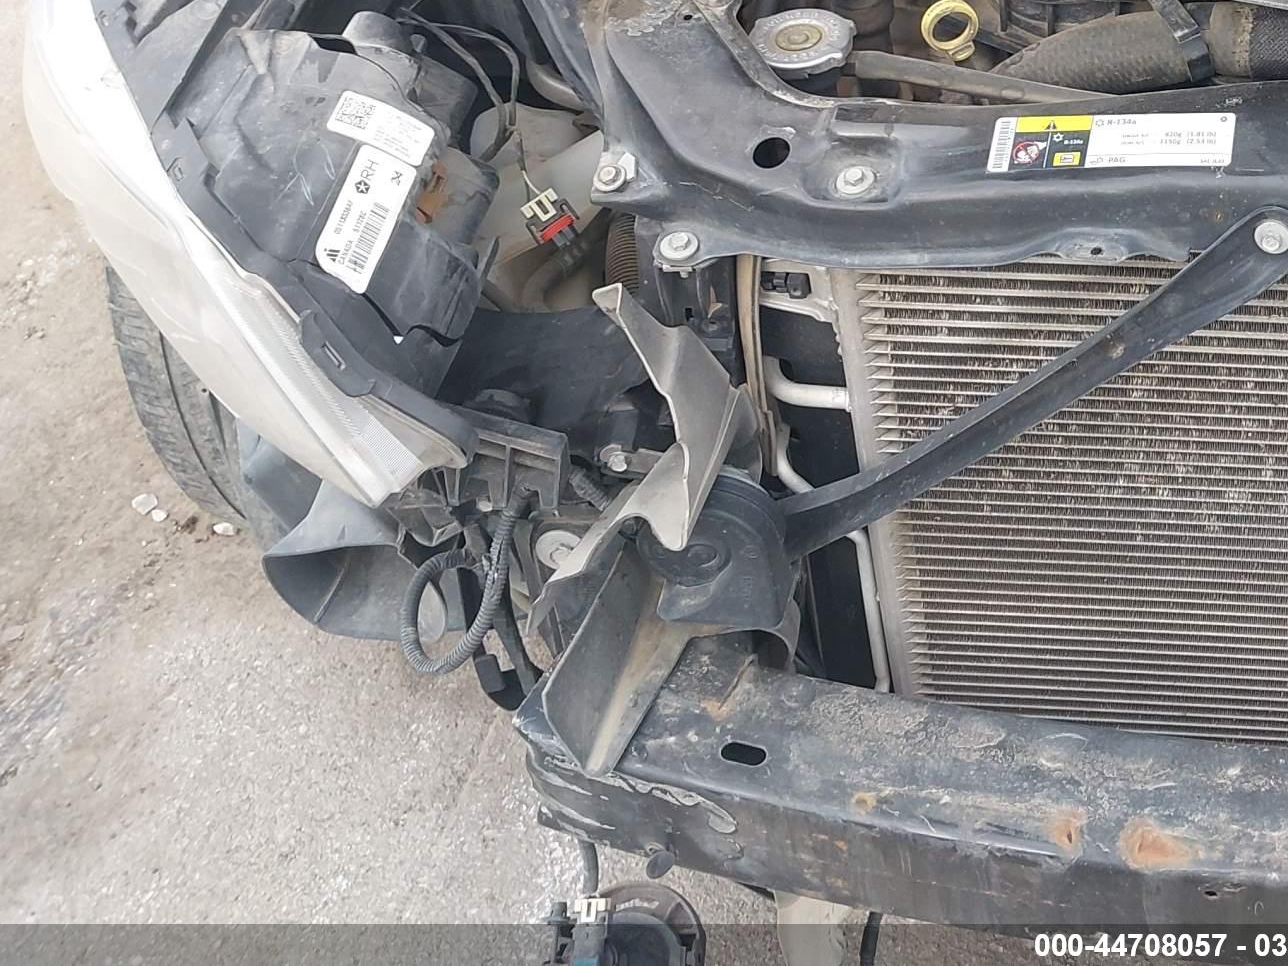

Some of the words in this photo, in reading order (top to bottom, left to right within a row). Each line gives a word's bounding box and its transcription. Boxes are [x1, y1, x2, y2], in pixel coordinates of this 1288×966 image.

[1107, 118, 1137, 126] R-134a
[363, 159, 379, 182] RH
[338, 240, 354, 266] CANADA
